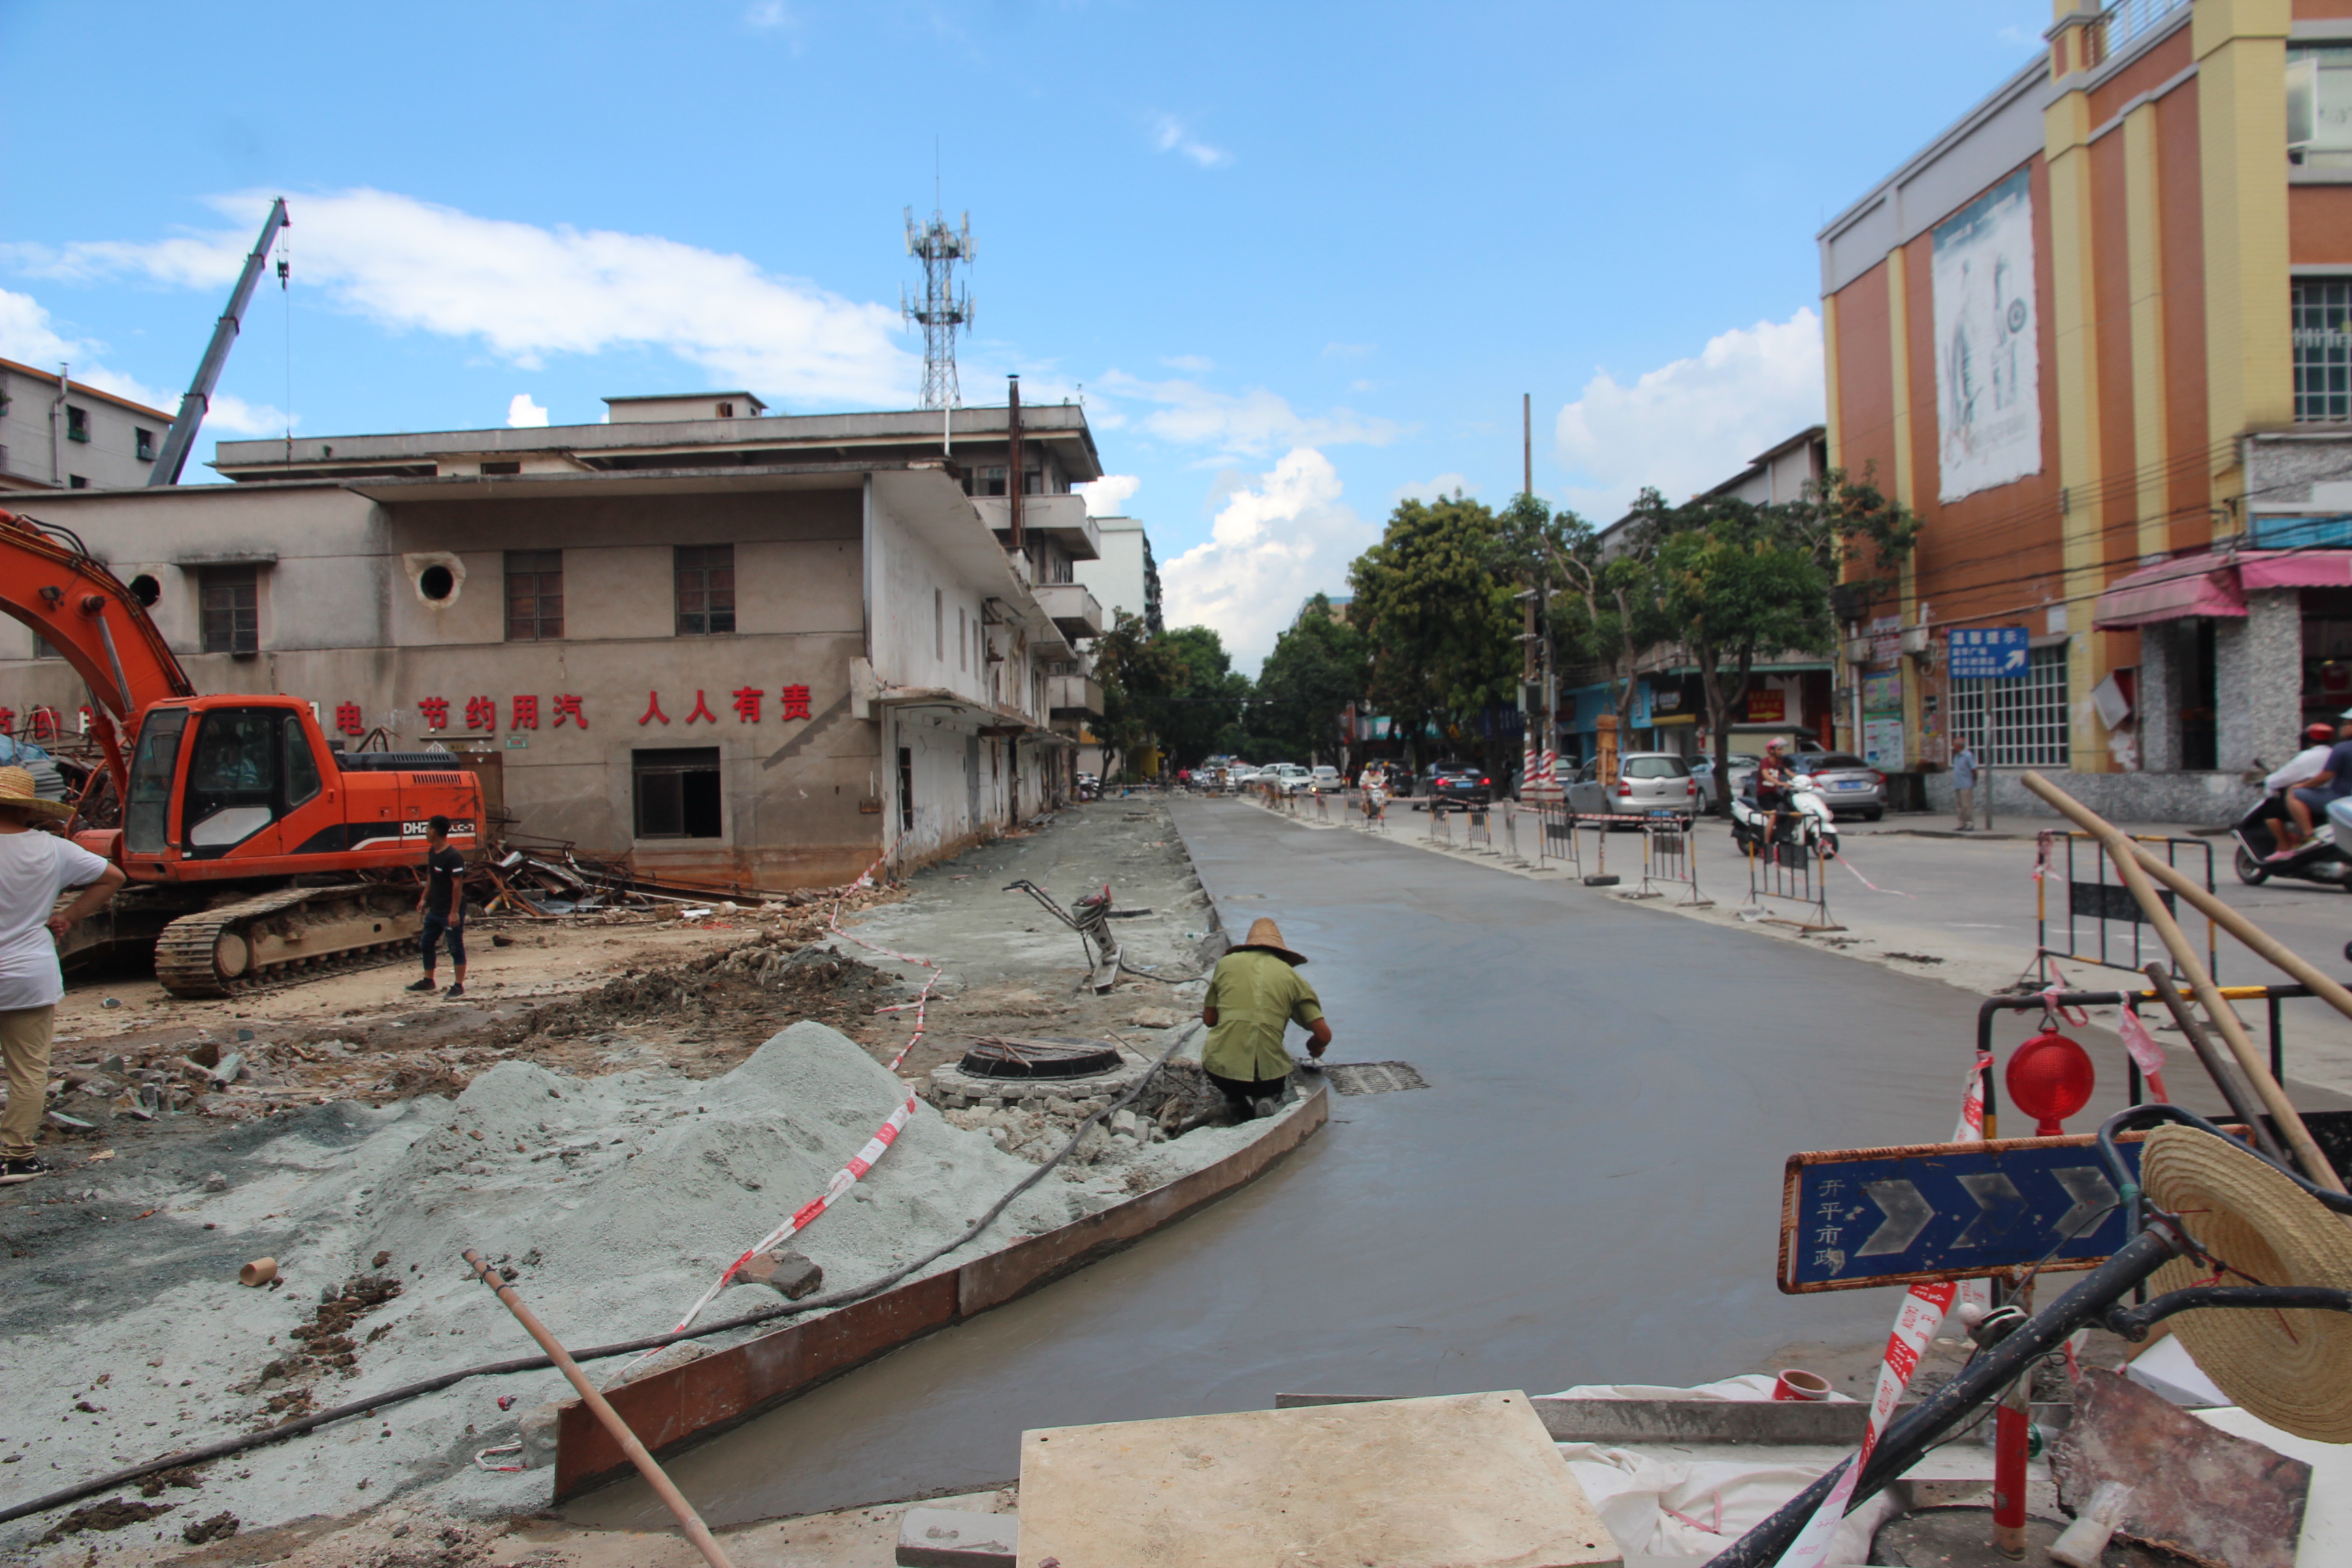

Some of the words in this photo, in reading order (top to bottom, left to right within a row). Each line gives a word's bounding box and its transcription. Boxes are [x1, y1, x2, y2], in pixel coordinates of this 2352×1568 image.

[418, 693, 589, 730] 节约用汽
[638, 683, 813, 724] 人人有责
[1891, 1340, 1909, 1373] SAFE
